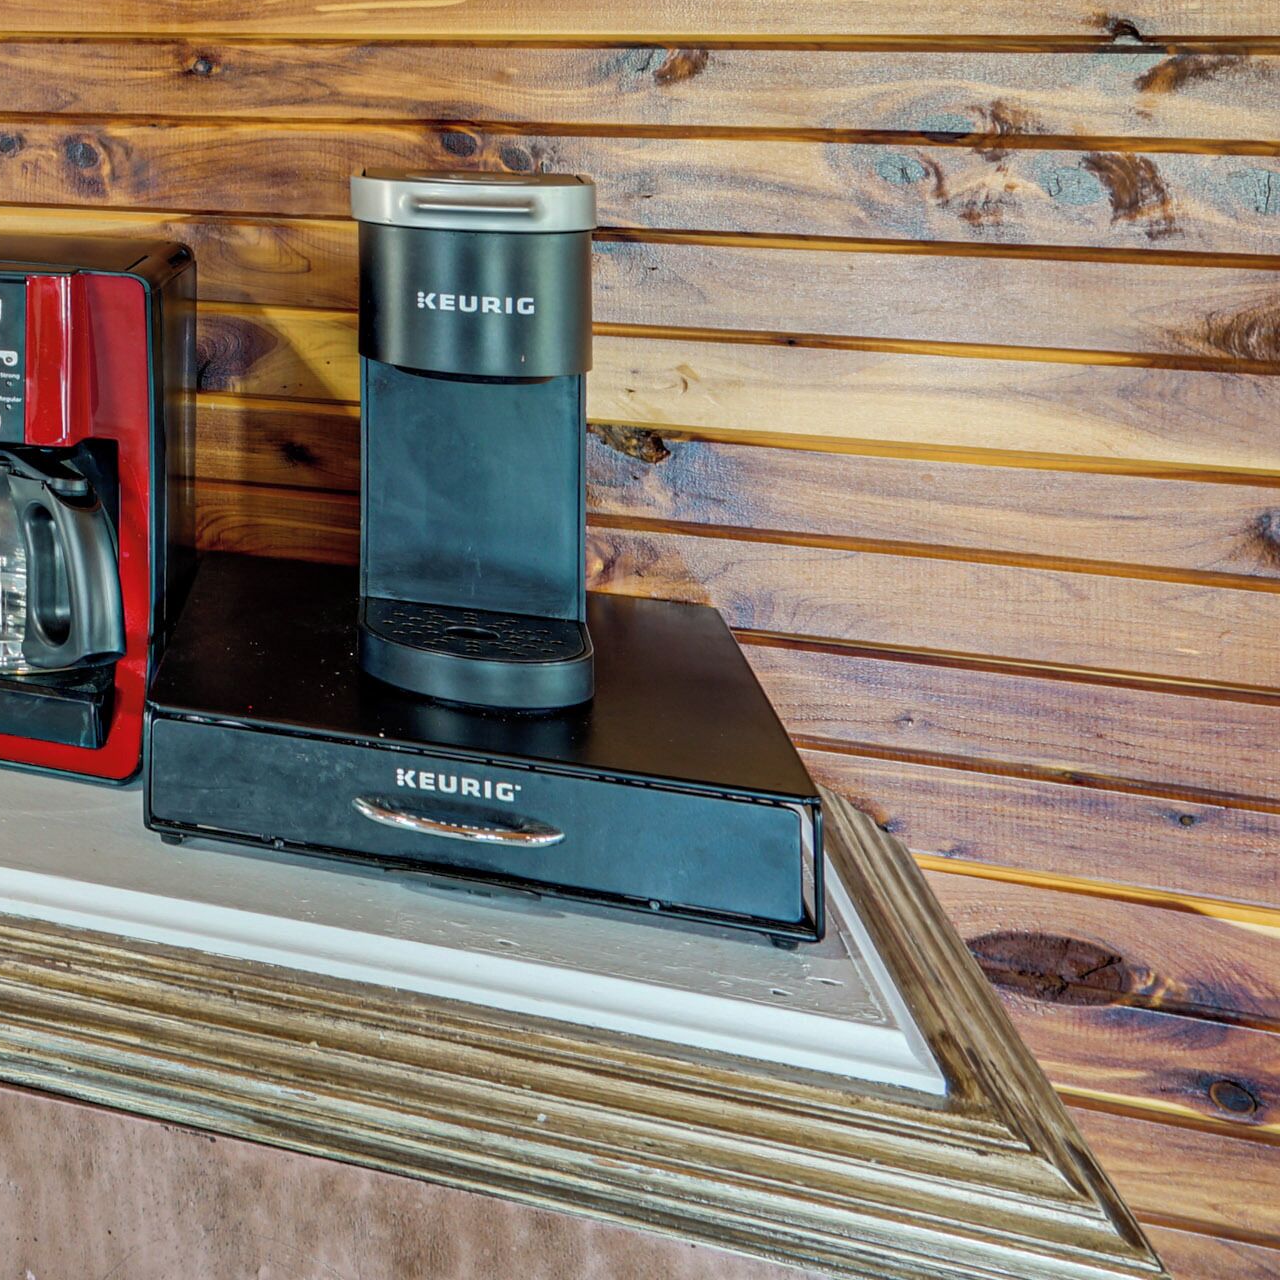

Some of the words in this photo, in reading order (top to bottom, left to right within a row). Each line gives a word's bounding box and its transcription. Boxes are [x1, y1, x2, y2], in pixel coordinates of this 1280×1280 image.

[416, 290, 535, 315] KEURIG
[0, 372, 20, 380] Strong
[396, 767, 516, 803] KEURIG
